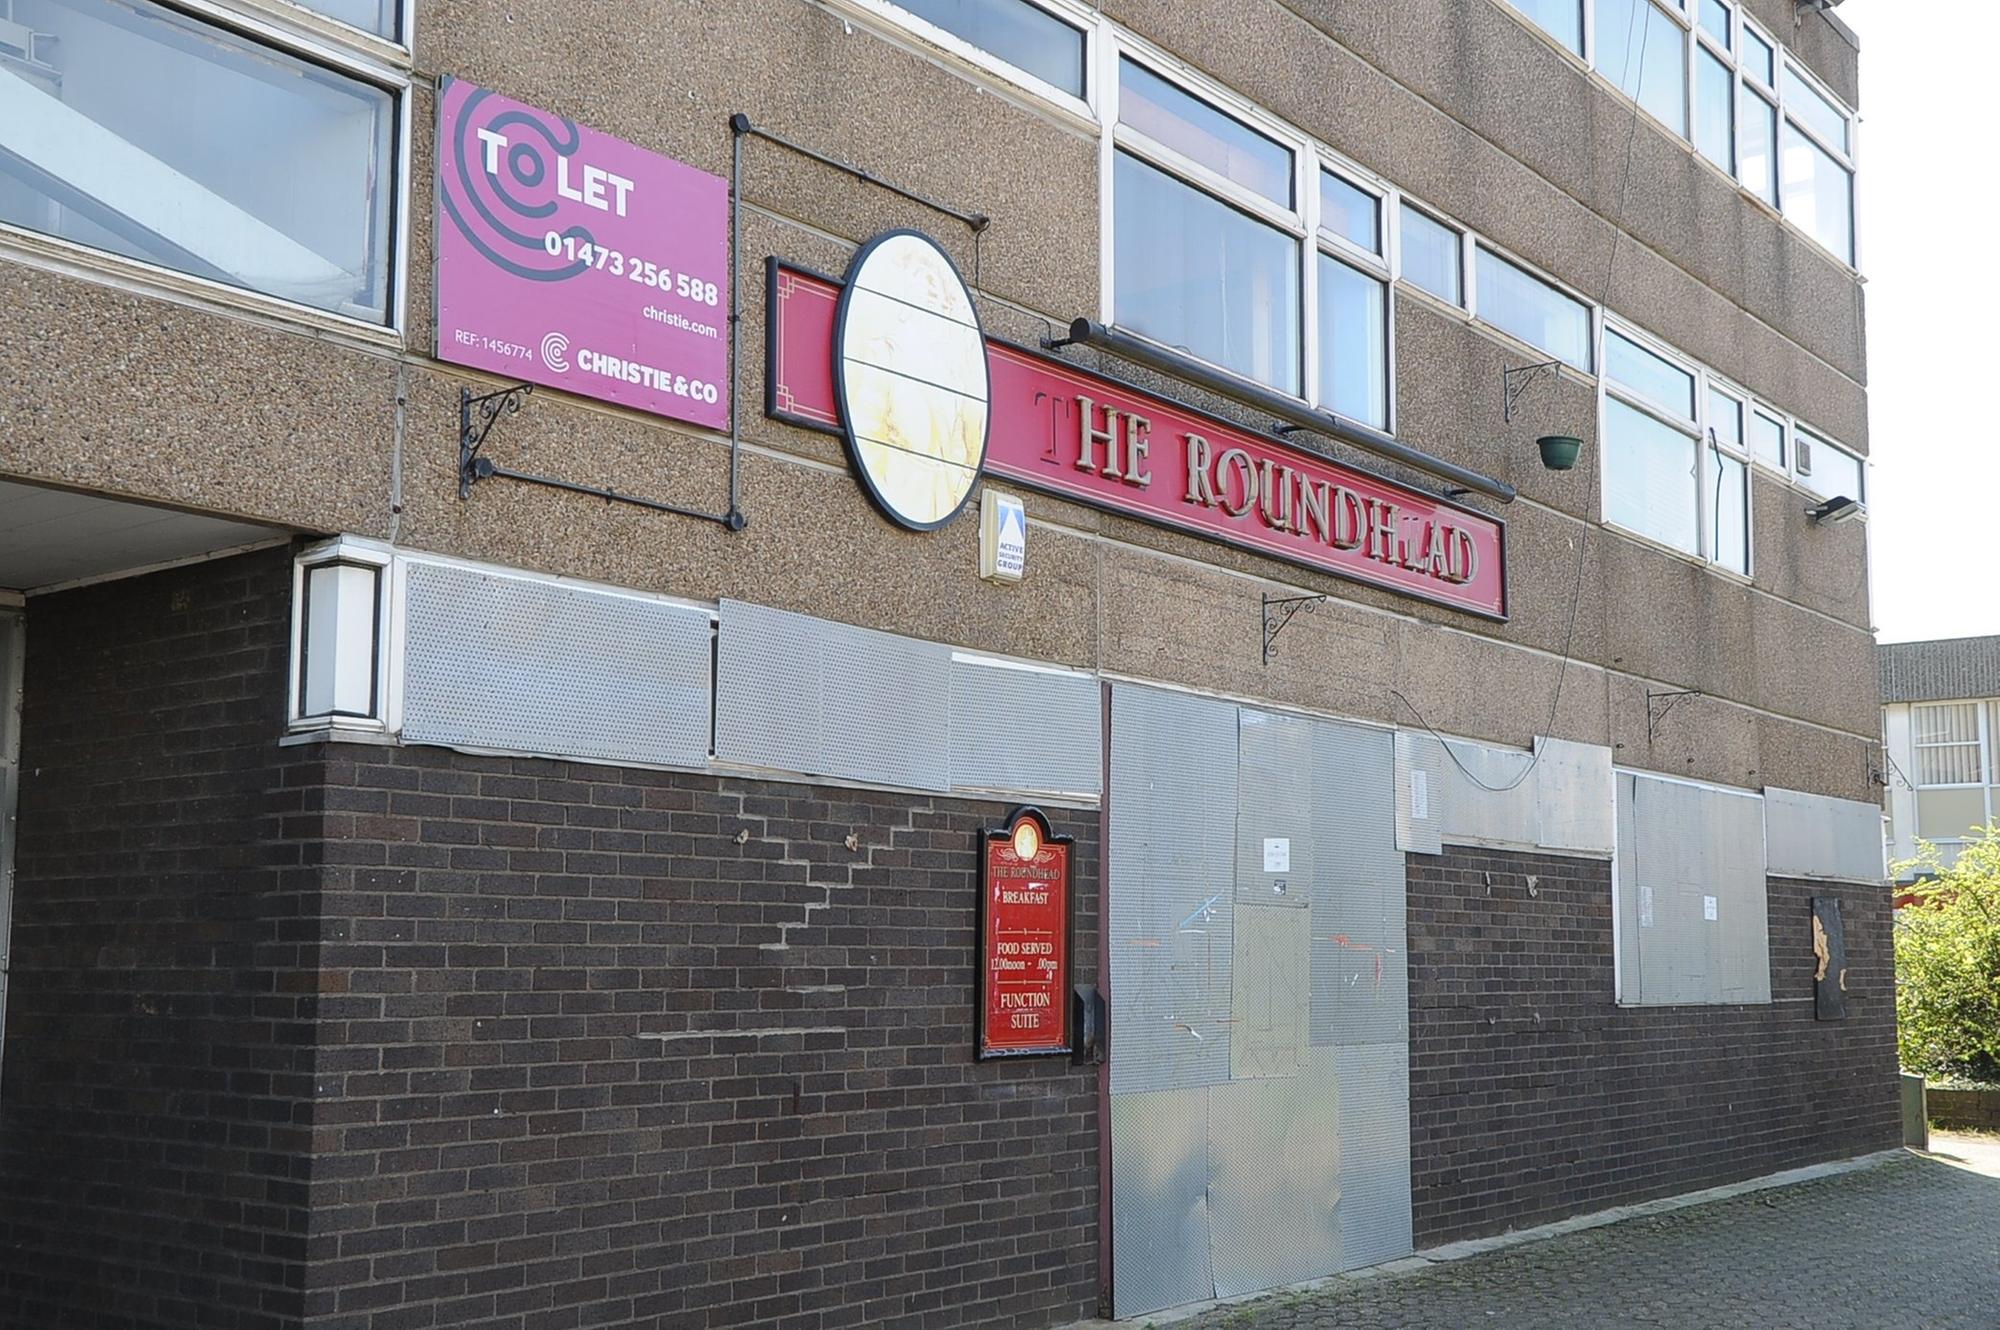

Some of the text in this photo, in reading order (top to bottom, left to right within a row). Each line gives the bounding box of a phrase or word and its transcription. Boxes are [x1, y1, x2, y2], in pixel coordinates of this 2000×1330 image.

[477, 128, 634, 218] TO LET
[544, 231, 719, 306] 01473 256 588
[643, 306, 718, 339] christie.com
[455, 328, 533, 361] REF: 1456774
[1000, 542, 1023, 554] ACTIVE
[999, 551, 1023, 562] SECURITY
[997, 559, 1022, 571] GROUP
[992, 866, 1008, 878] THE
[1002, 890, 1049, 905] BREAKFAST
[997, 942, 1053, 955] FOOD SERVED
[1000, 991, 1051, 1009] FUNCTION
[1010, 1013, 1040, 1029] SUITE
